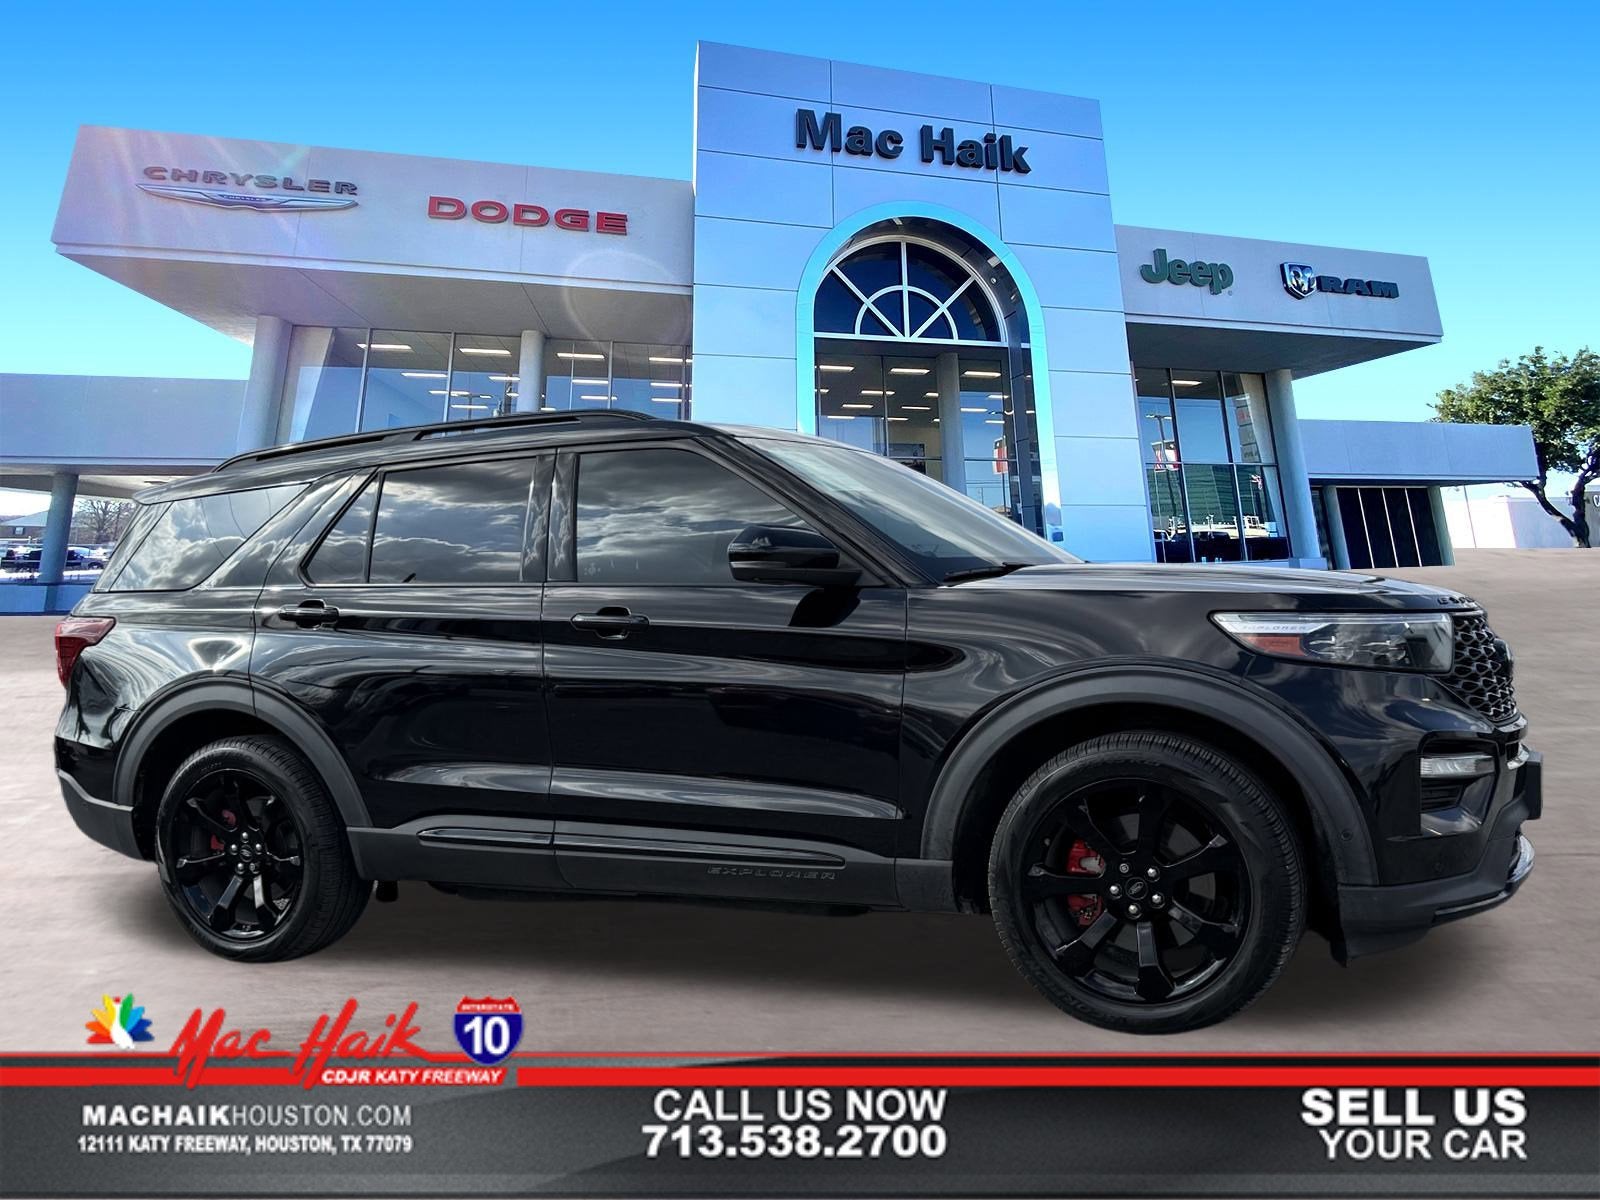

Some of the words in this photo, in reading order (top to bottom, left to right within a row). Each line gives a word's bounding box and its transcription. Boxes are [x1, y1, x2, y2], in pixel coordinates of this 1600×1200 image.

[796, 108, 904, 159] Mac
[919, 124, 1032, 174] Haik
[143, 166, 358, 196] CHRYSLER
[428, 196, 628, 236] DODGE
[1140, 248, 1234, 296] Jeep
[1316, 275, 1399, 299] RAM
[707, 866, 836, 881] EXPLORER
